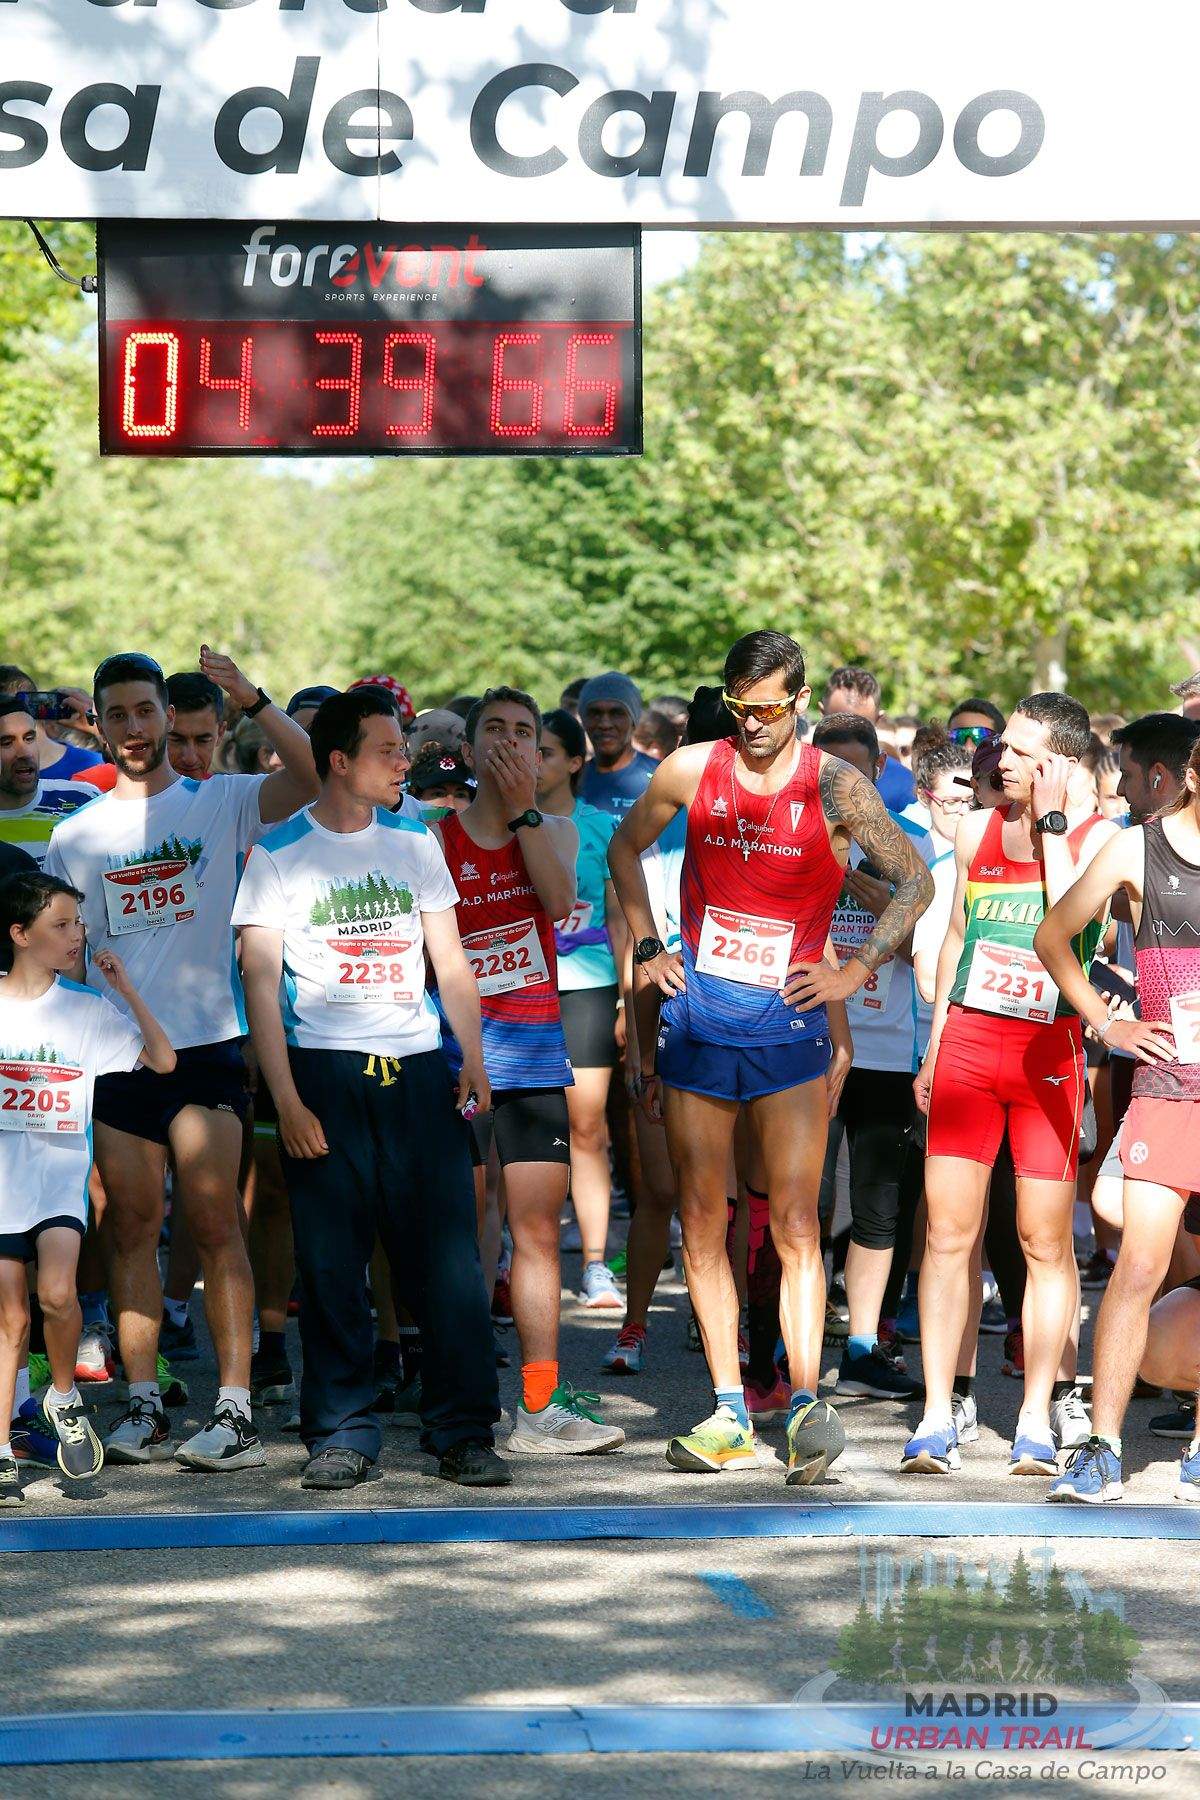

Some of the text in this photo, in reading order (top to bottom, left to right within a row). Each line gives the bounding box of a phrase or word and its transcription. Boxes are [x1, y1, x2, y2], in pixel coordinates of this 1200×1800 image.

[213, 56, 414, 177] de
[470, 62, 1045, 207] Campo
[242, 225, 487, 288] forevent
[324, 293, 438, 301] SPORTS EXPERIENCE
[704, 834, 802, 857] A.D. MARATHON
[120, 884, 185, 915] 2196
[462, 885, 537, 907] A.D. MARATHO
[976, 899, 1043, 926] BIKIL
[338, 921, 392, 936] MADRID
[831, 924, 875, 935] BAN TRA
[469, 947, 532, 978] 2282
[712, 935, 776, 967] 2266
[339, 962, 404, 984] 2238
[981, 969, 1044, 1002] 2231
[2, 1087, 71, 1113] 2205
